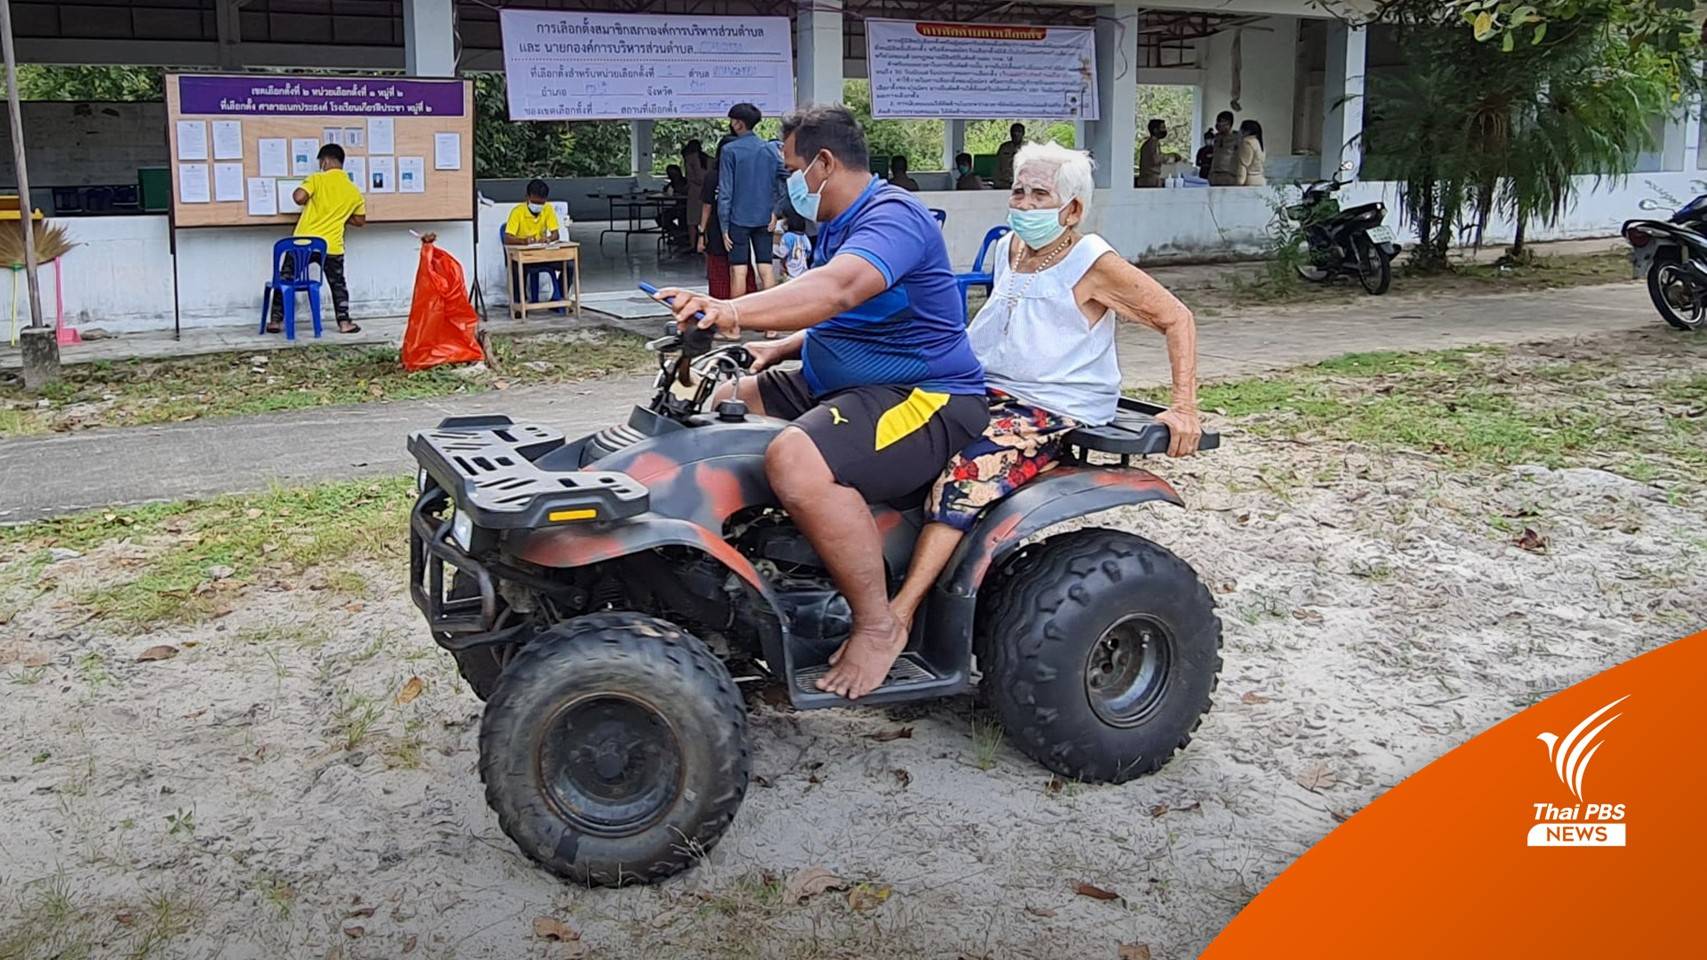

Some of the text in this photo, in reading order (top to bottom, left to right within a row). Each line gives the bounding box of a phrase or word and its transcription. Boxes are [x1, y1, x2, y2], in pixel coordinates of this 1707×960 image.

[537, 17, 764, 37] การเลือกตั้งสมาชิกสภาองค์การบริหารส่วนตำบล
[519, 42, 540, 53] และ
[251, 82, 300, 96] เขตเลือกตั้งที่
[312, 83, 367, 97] หน่วยเลือกตั้งที่
[378, 85, 395, 100] หมู่ที่
[220, 98, 256, 111] ที่เลือกตั้ง
[407, 100, 424, 115] หมู่ที่
